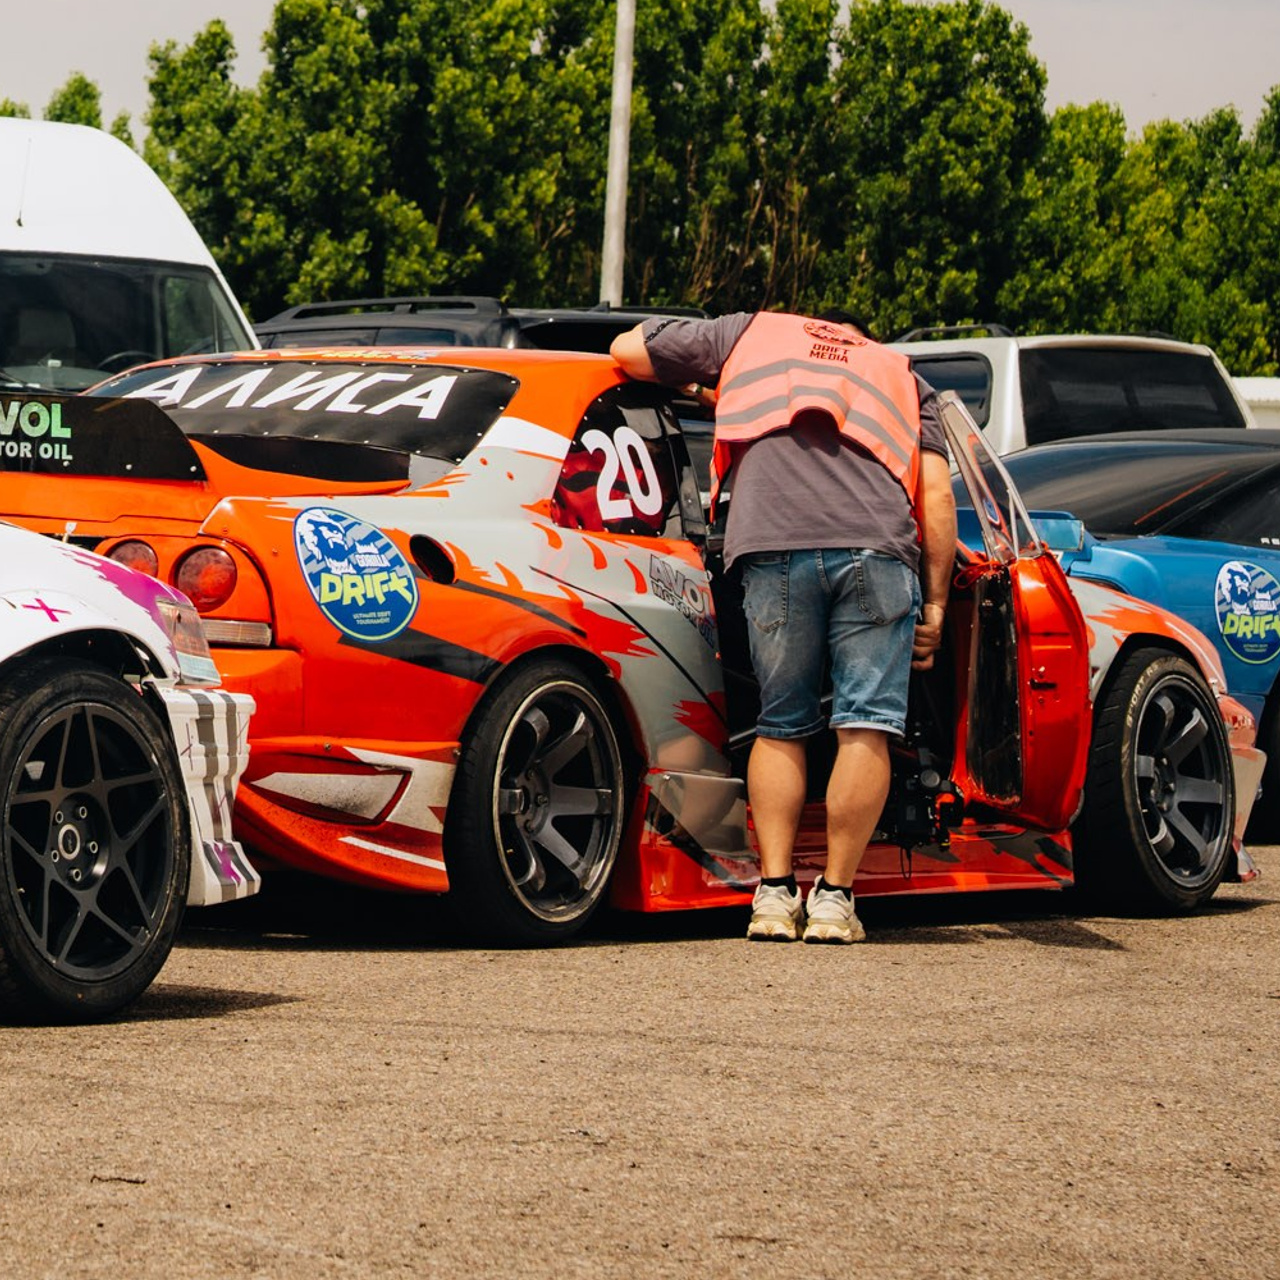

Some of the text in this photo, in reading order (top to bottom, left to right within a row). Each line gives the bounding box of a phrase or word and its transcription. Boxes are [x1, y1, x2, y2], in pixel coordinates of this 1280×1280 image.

[809, 350, 849, 364] MEDIA
[812, 343, 850, 355] DRIFT
[121, 367, 458, 420] АЛИСА
[39, 443, 73, 460] OIL
[581, 426, 663, 521] 20
[320, 571, 413, 607] DRIFT
